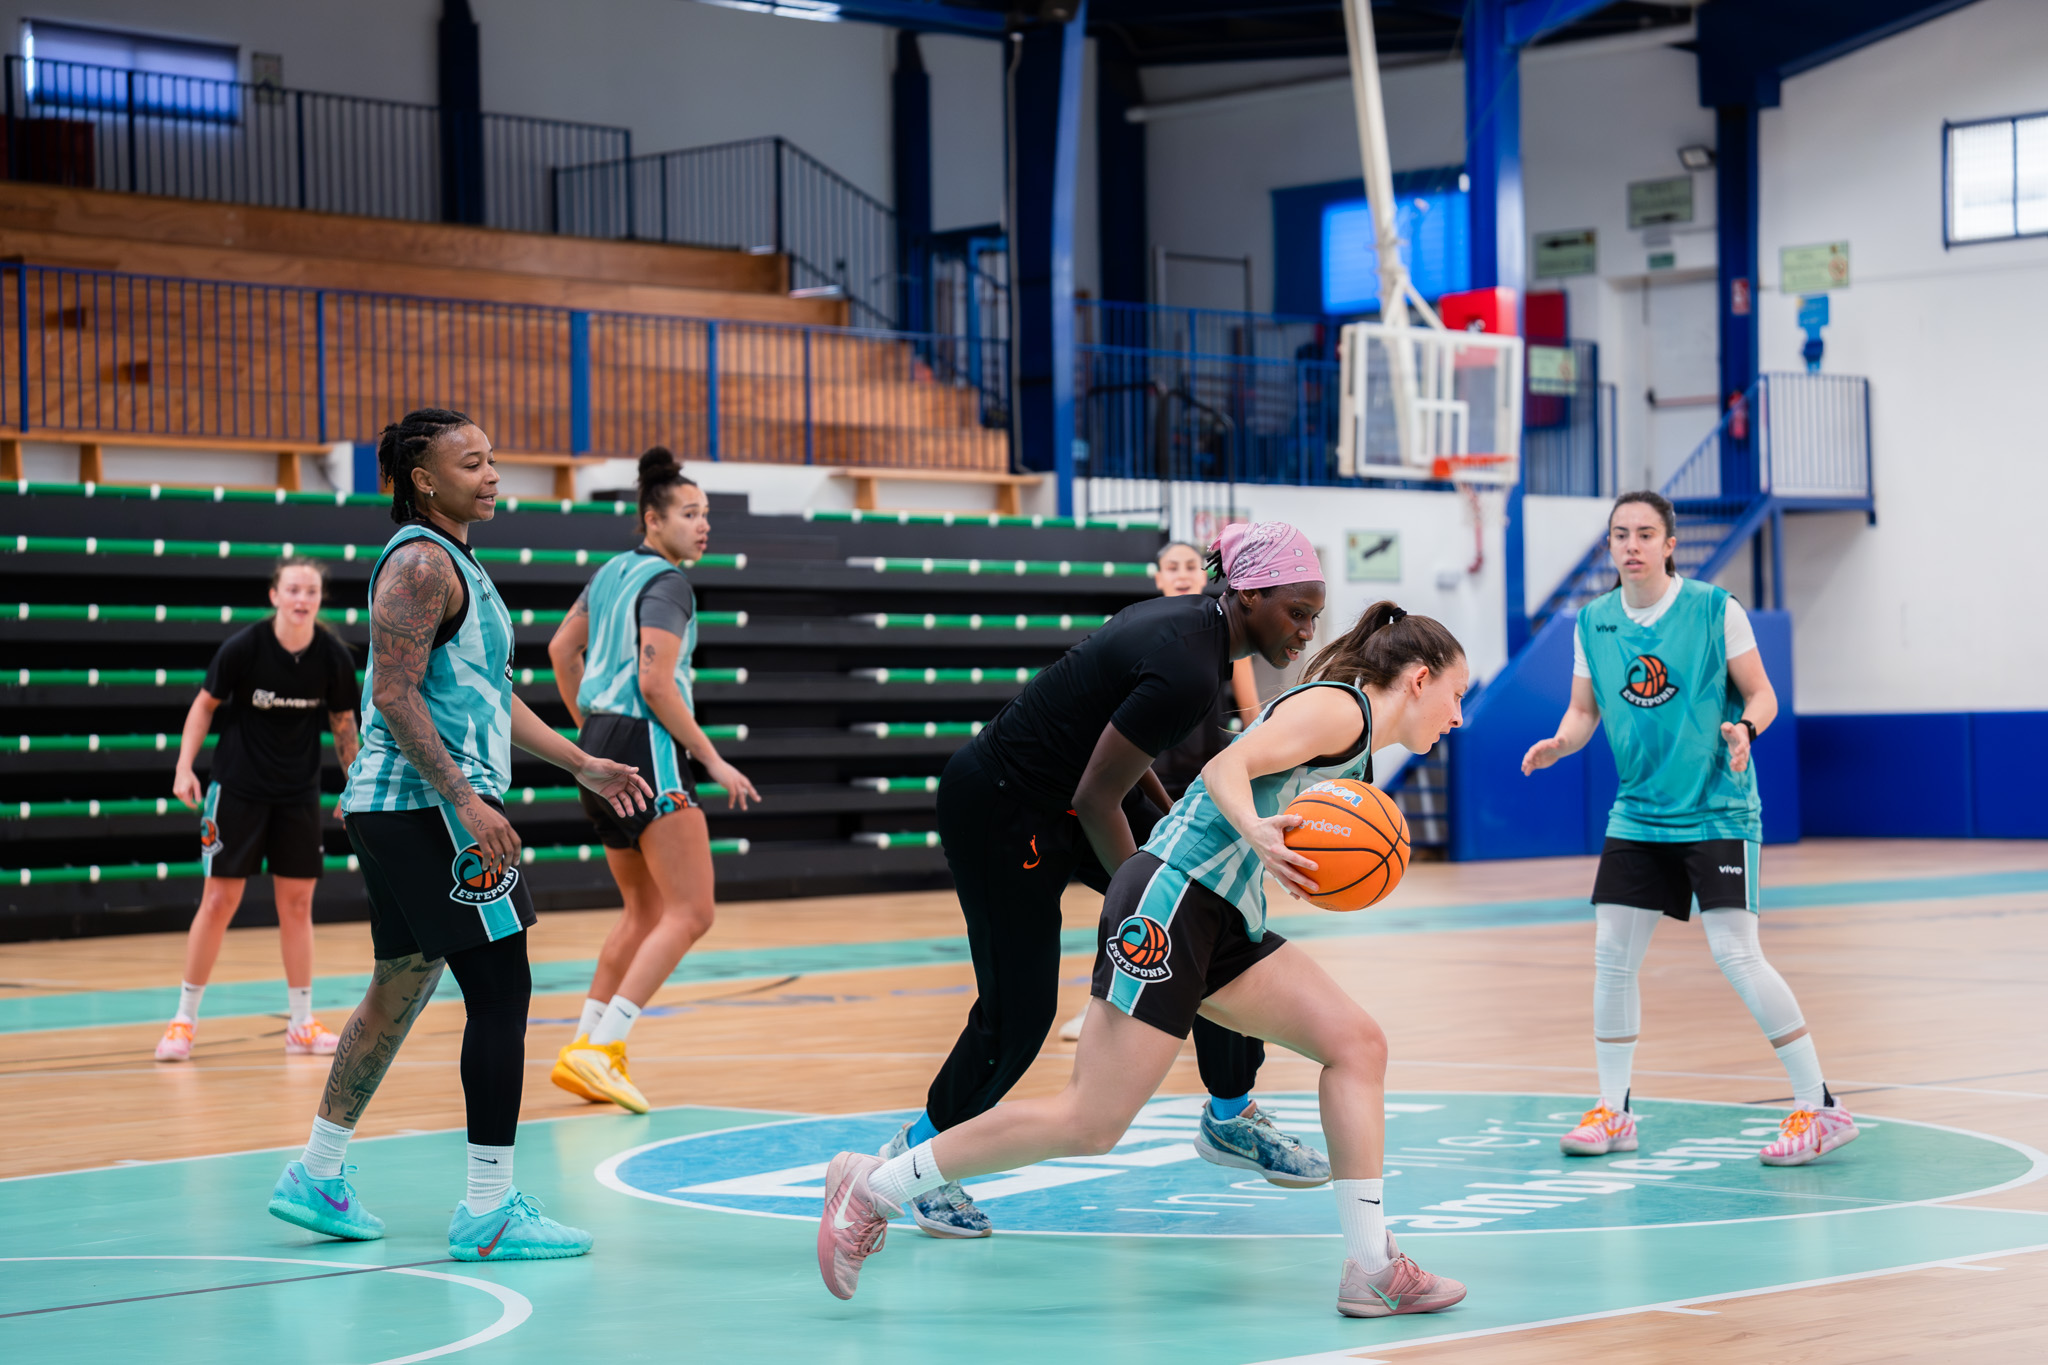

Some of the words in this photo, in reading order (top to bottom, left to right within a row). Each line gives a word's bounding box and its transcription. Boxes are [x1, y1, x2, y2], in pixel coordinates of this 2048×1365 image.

[1596, 624, 1618, 633] vive
[1622, 686, 1676, 706] ESTEPONA
[1298, 819, 1352, 837] endesa
[1718, 865, 1743, 875] vive
[457, 872, 514, 900] ESTEPONA
[1109, 942, 1166, 977] ESTEPONA
